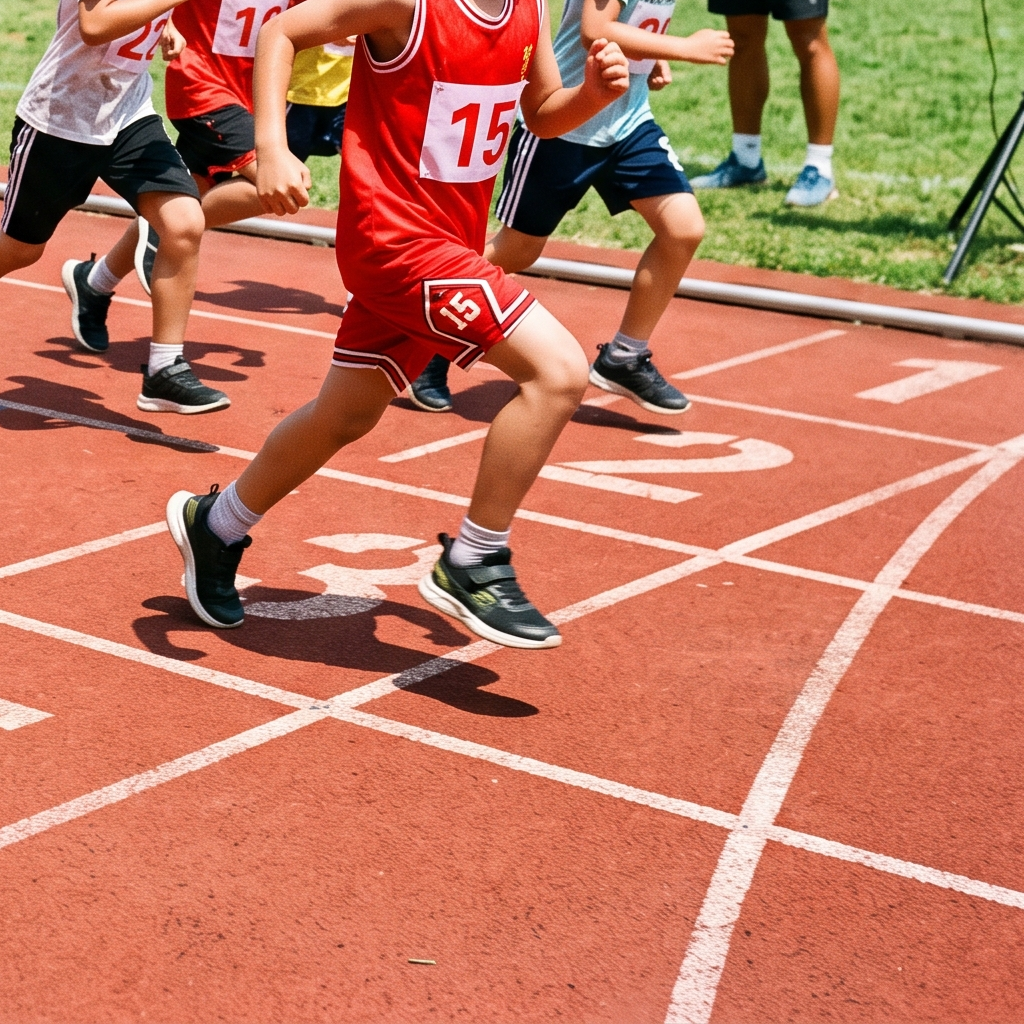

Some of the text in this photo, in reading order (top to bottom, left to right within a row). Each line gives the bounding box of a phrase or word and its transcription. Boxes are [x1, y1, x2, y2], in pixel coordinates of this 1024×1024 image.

[451, 100, 517, 167] 15
[439, 291, 481, 330] 15
[855, 357, 1004, 404] 1
[537, 431, 794, 504] 2
